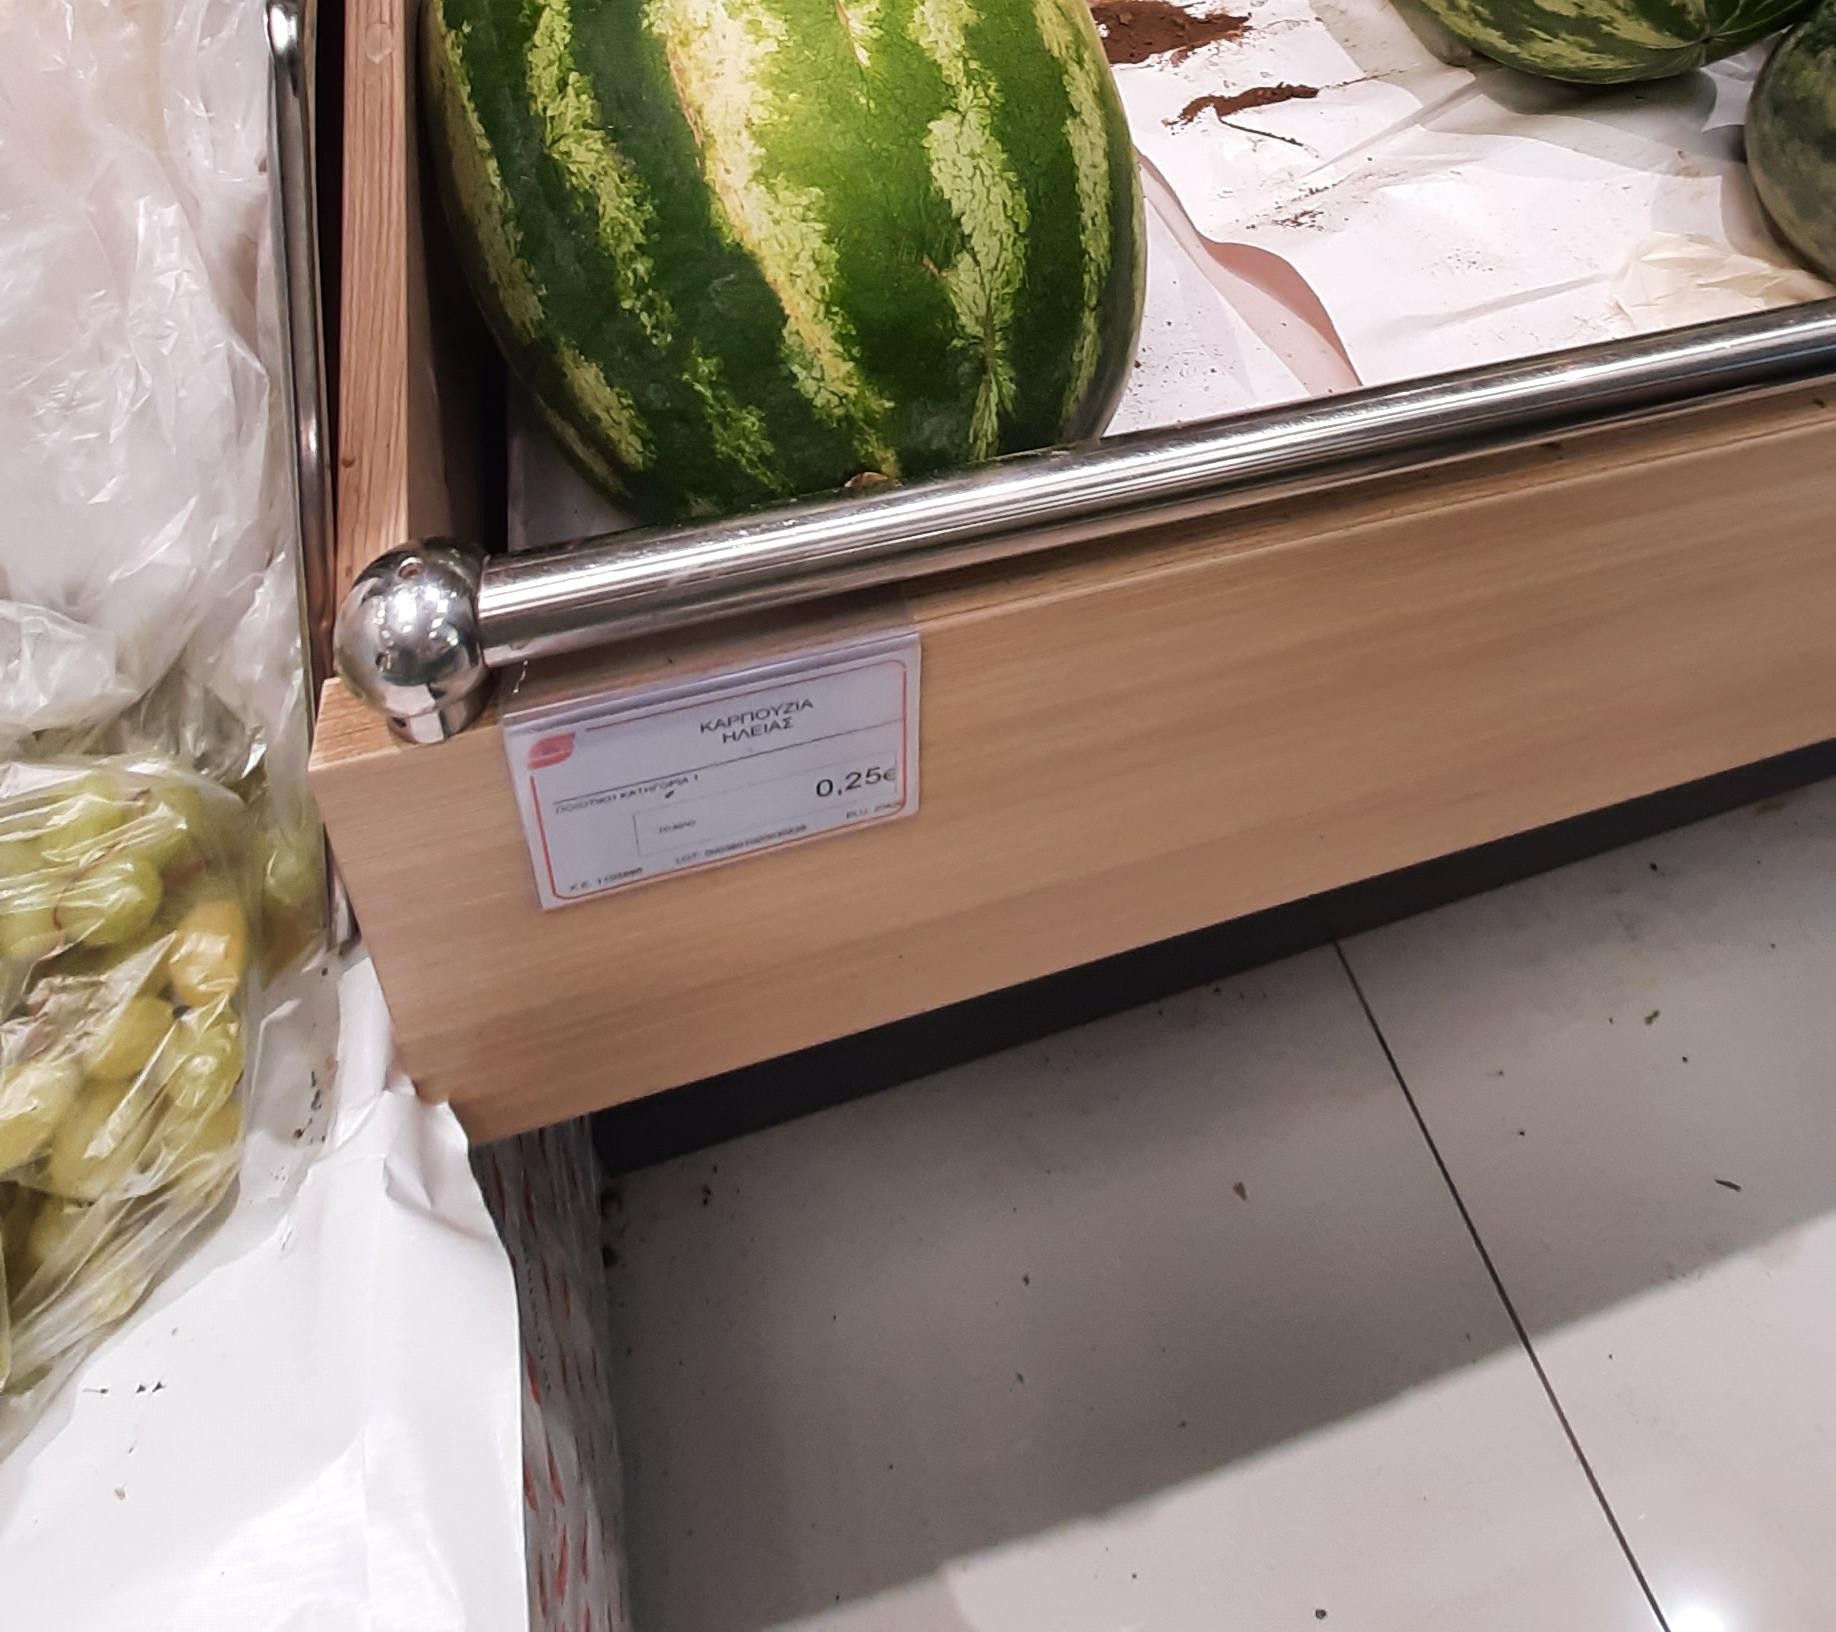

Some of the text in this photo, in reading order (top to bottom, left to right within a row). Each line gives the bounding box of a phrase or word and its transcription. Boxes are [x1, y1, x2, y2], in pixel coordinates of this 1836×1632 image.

[700, 698, 814, 734] ΚΑΡΠΟΥΖΙΑ
[722, 717, 794, 744] ΗΛΕΙΑΣ
[816, 767, 897, 798] 0,25€
